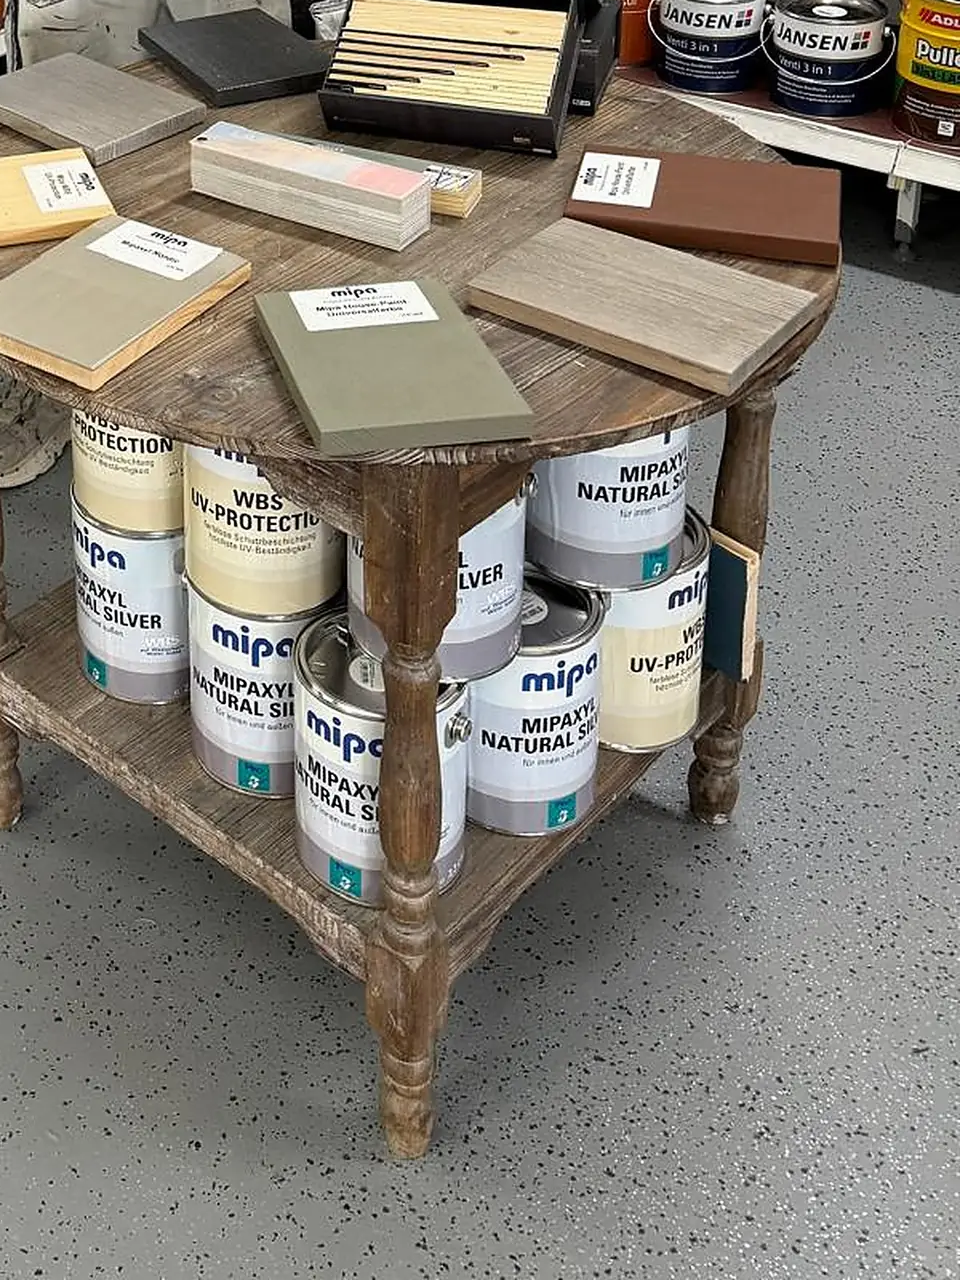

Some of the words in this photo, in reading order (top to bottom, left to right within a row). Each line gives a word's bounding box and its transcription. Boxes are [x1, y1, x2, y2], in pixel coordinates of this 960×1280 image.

[664, 0, 733, 28] JANSEN
[690, 41, 697, 51] 3
[699, 42, 710, 52] in
[777, 22, 849, 51] JANSEN
[778, 56, 801, 71] Venti
[803, 62, 809, 73] 3
[812, 64, 823, 74] in
[151, 231, 187, 247] mipa
[331, 287, 377, 298] mipa
[620, 448, 688, 483] MIPAXYL
[233, 489, 284, 511] WBS
[578, 481, 670, 504] NATURAL
[104, 606, 162, 629] SILVER
[212, 623, 294, 667] mipa
[522, 653, 597, 697] mipa
[193, 667, 264, 717] NATURAL
[522, 697, 595, 734] MIPAXYL
[482, 729, 574, 754] NATURAL
